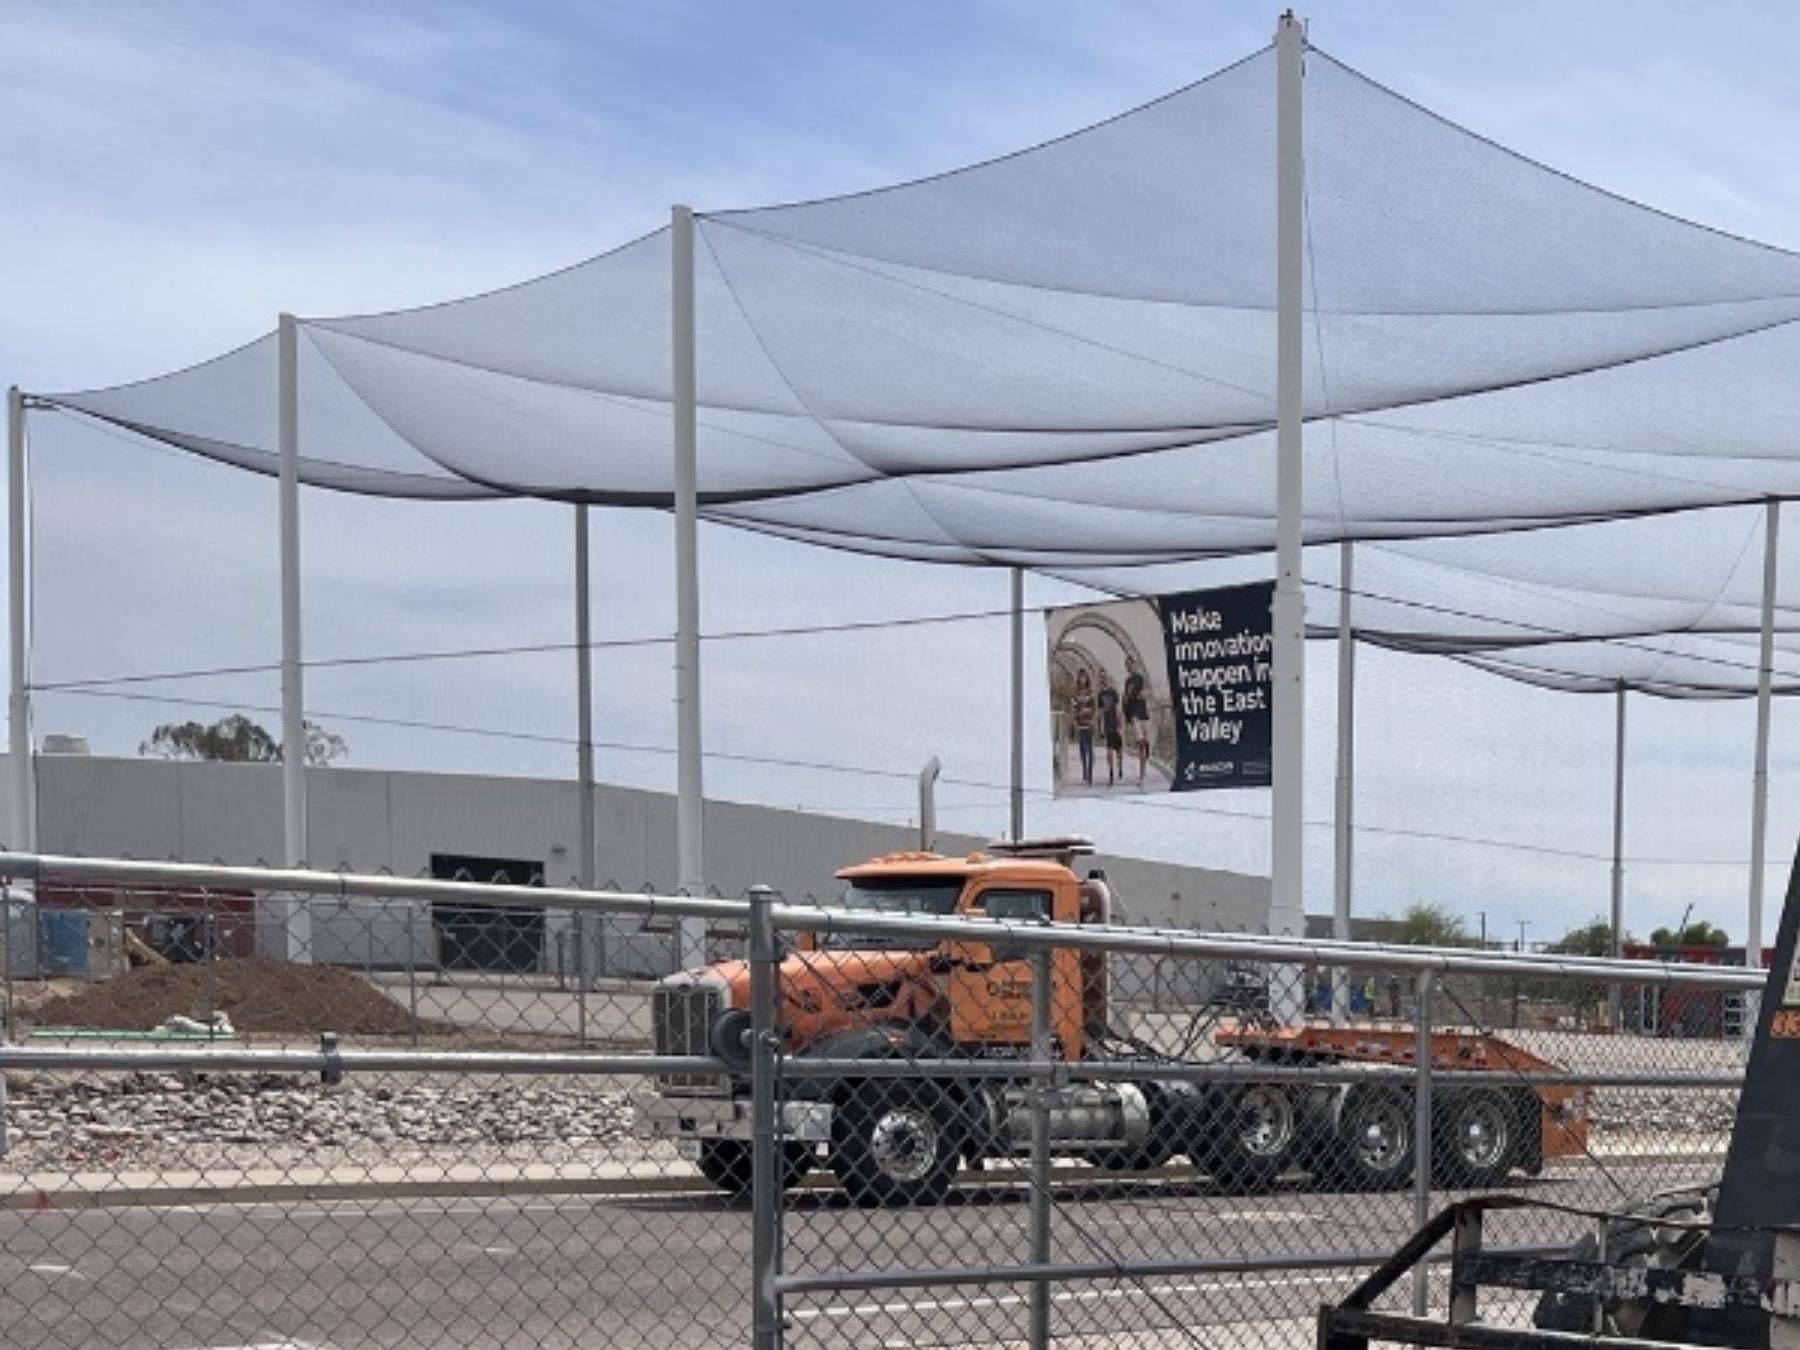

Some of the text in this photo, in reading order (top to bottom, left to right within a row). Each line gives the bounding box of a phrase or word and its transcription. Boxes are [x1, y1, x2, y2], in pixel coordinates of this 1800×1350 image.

[1169, 605, 1222, 634] Make
[1173, 629, 1273, 661] innovation
[1178, 655, 1272, 692] happen in
[1181, 687, 1267, 715] the East
[1184, 716, 1243, 745] Valley
